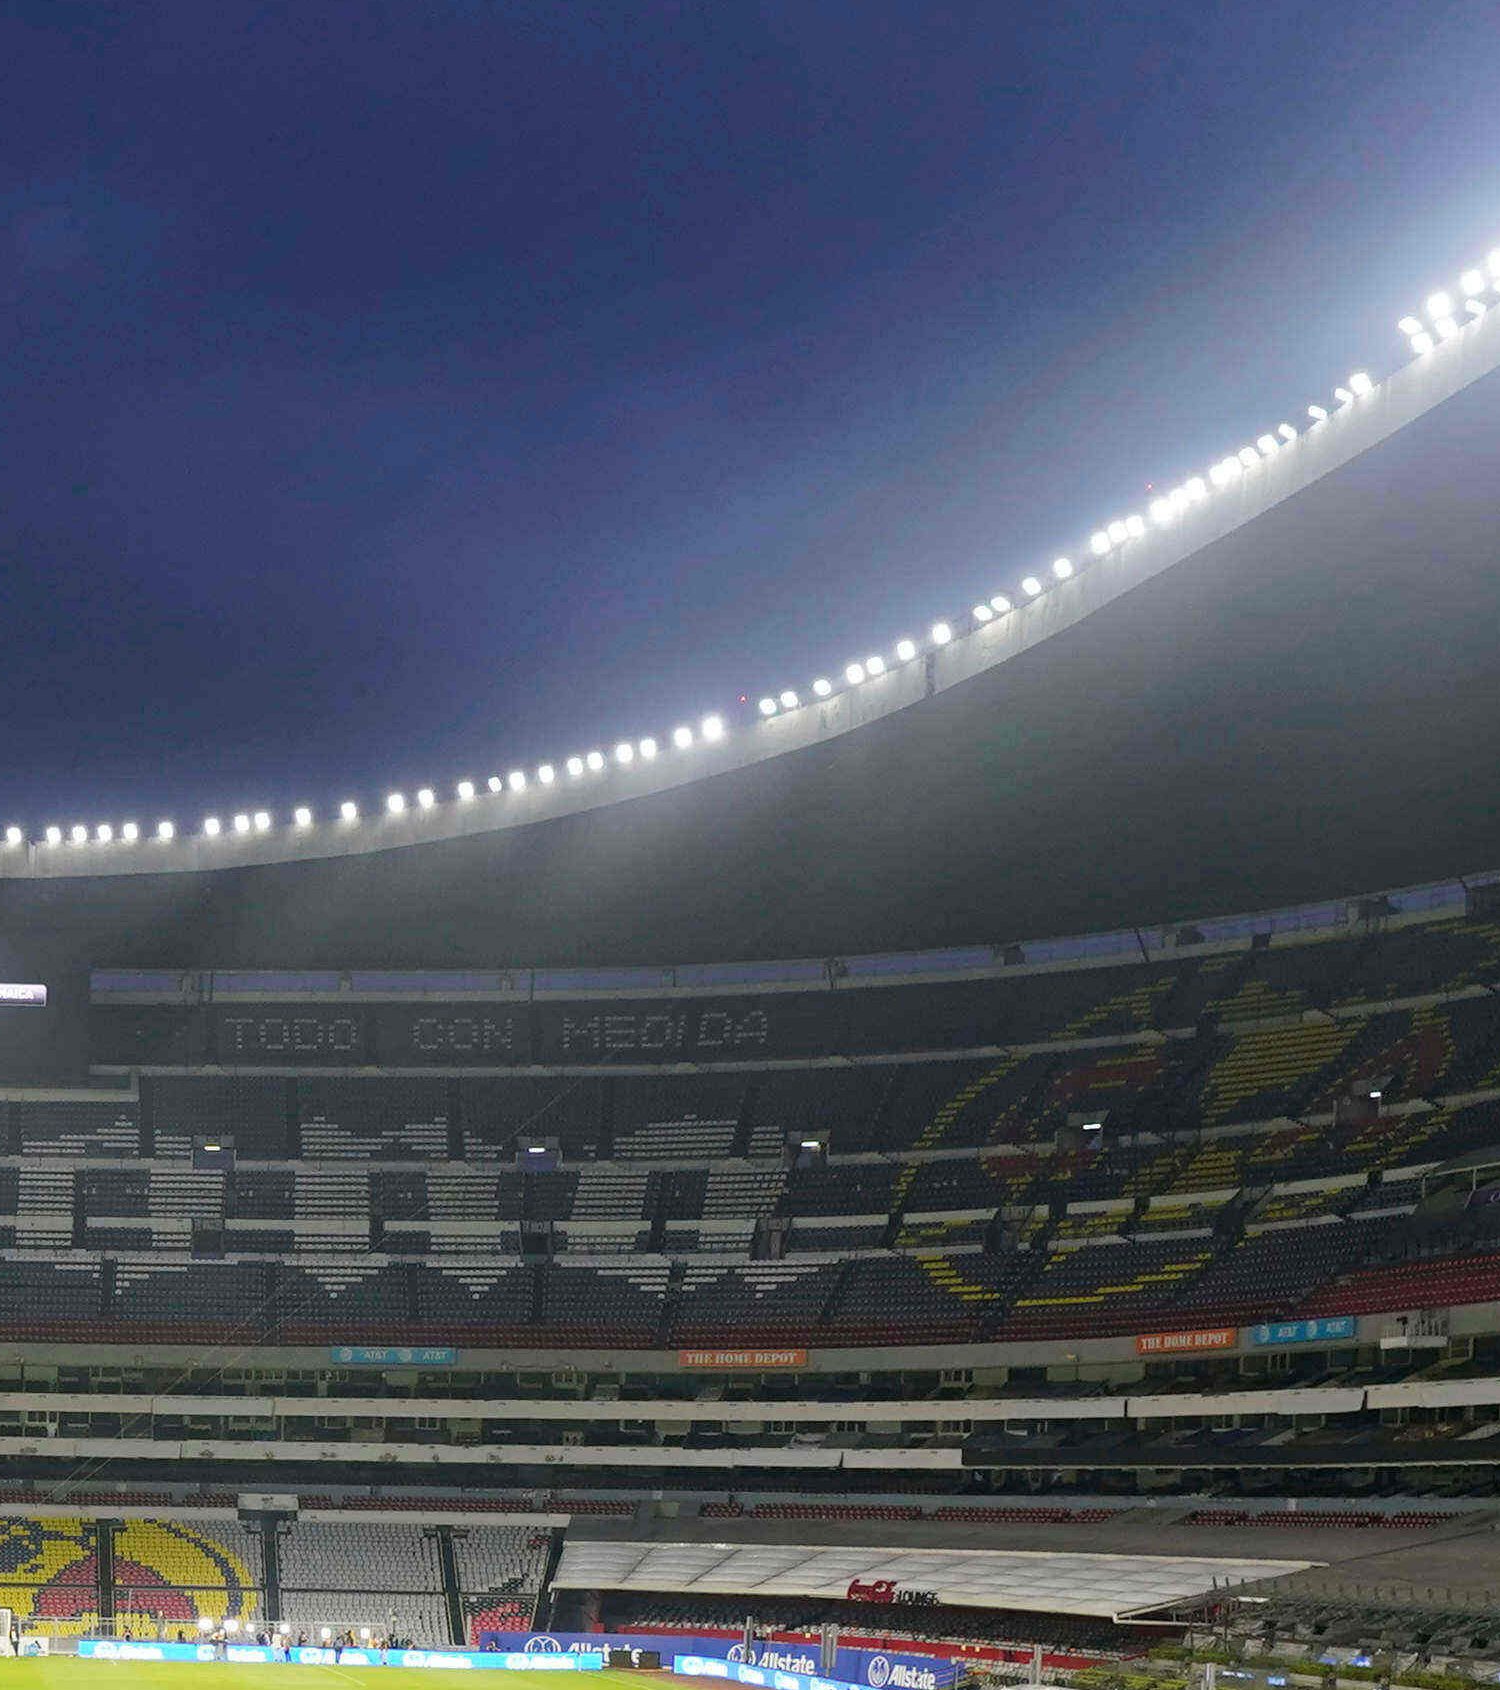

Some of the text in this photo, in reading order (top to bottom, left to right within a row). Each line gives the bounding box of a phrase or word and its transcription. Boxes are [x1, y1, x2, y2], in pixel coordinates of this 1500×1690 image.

[1141, 1331, 1228, 1350] THE HOME DEPOT
[686, 1352, 797, 1364] THE HOME DEPOT
[758, 1651, 816, 1675] Allstate
[888, 1664, 938, 1690] Allstate
